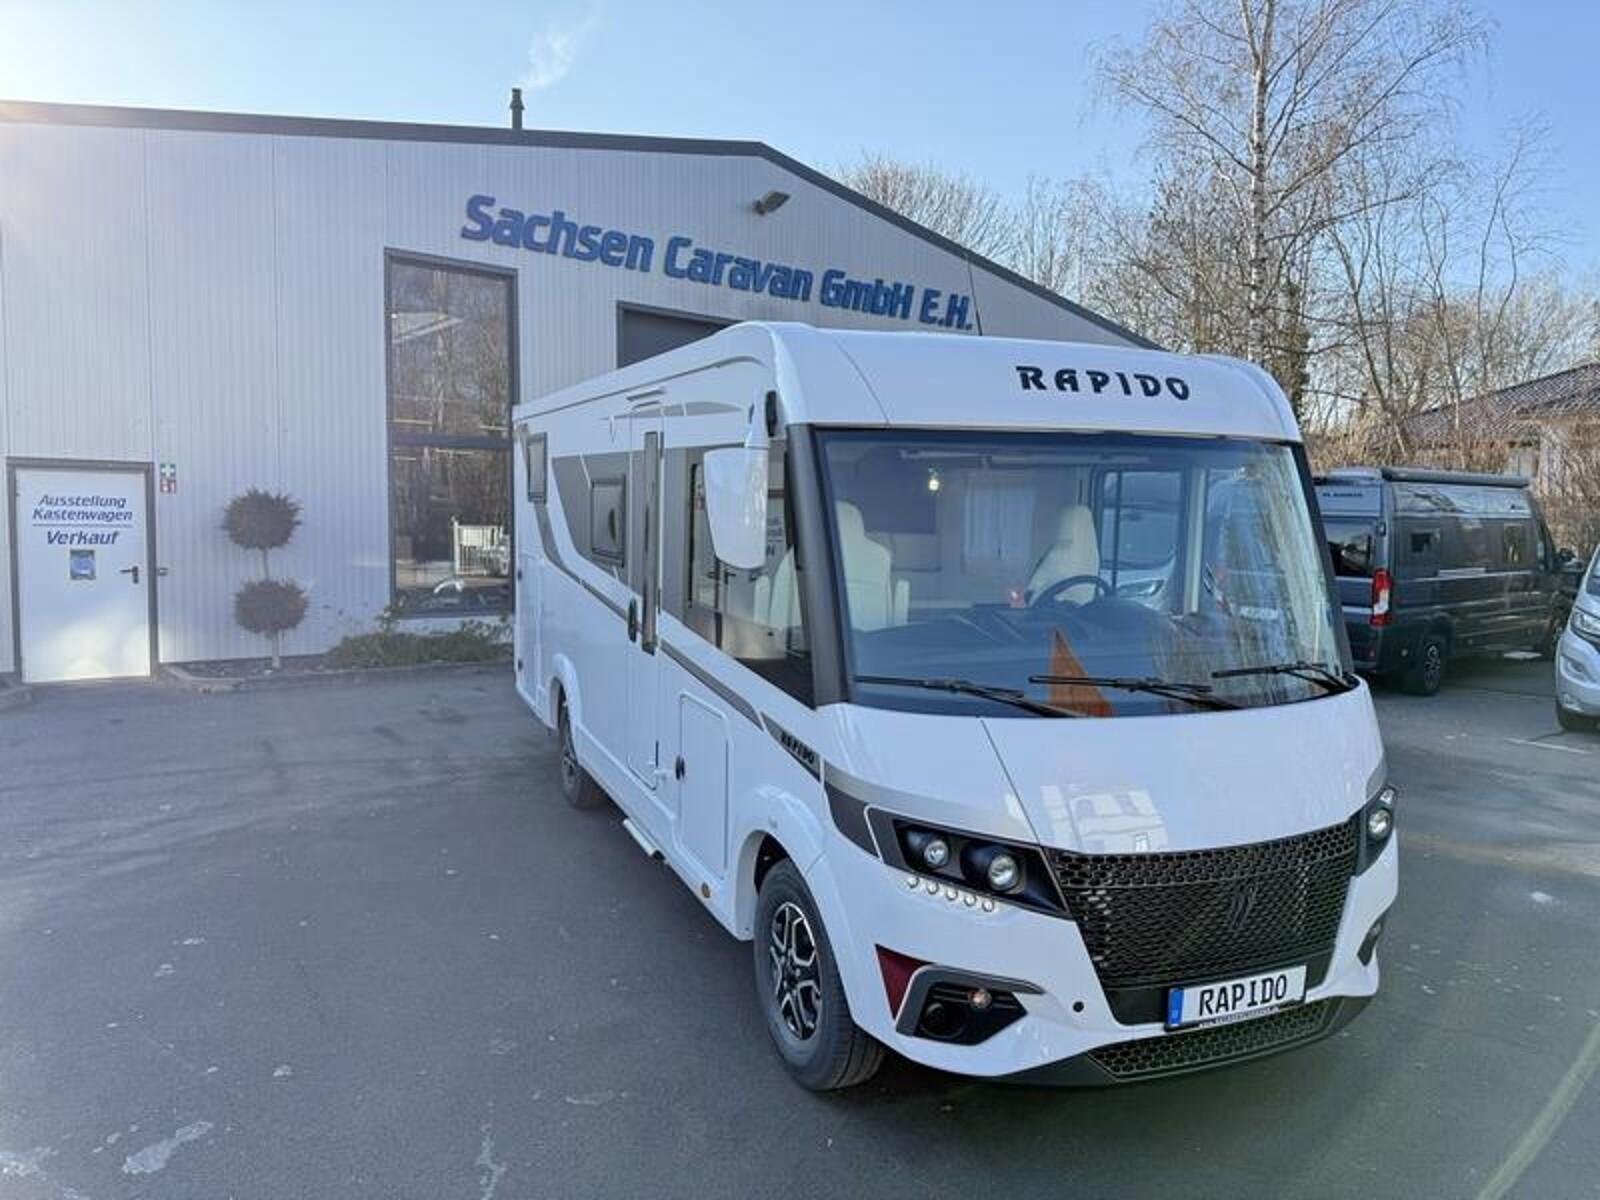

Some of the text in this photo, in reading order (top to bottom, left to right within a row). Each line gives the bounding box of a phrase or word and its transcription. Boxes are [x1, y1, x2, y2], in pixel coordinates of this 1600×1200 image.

[461, 194, 973, 330] Sachsen Caravan GmbH E.H.
[1015, 366, 1190, 401] RAPIDO
[38, 494, 127, 509] Ausstellung
[32, 508, 133, 522] Kastenwagen
[47, 530, 119, 545] Verkauf
[1199, 974, 1288, 1017] RAPIDO
